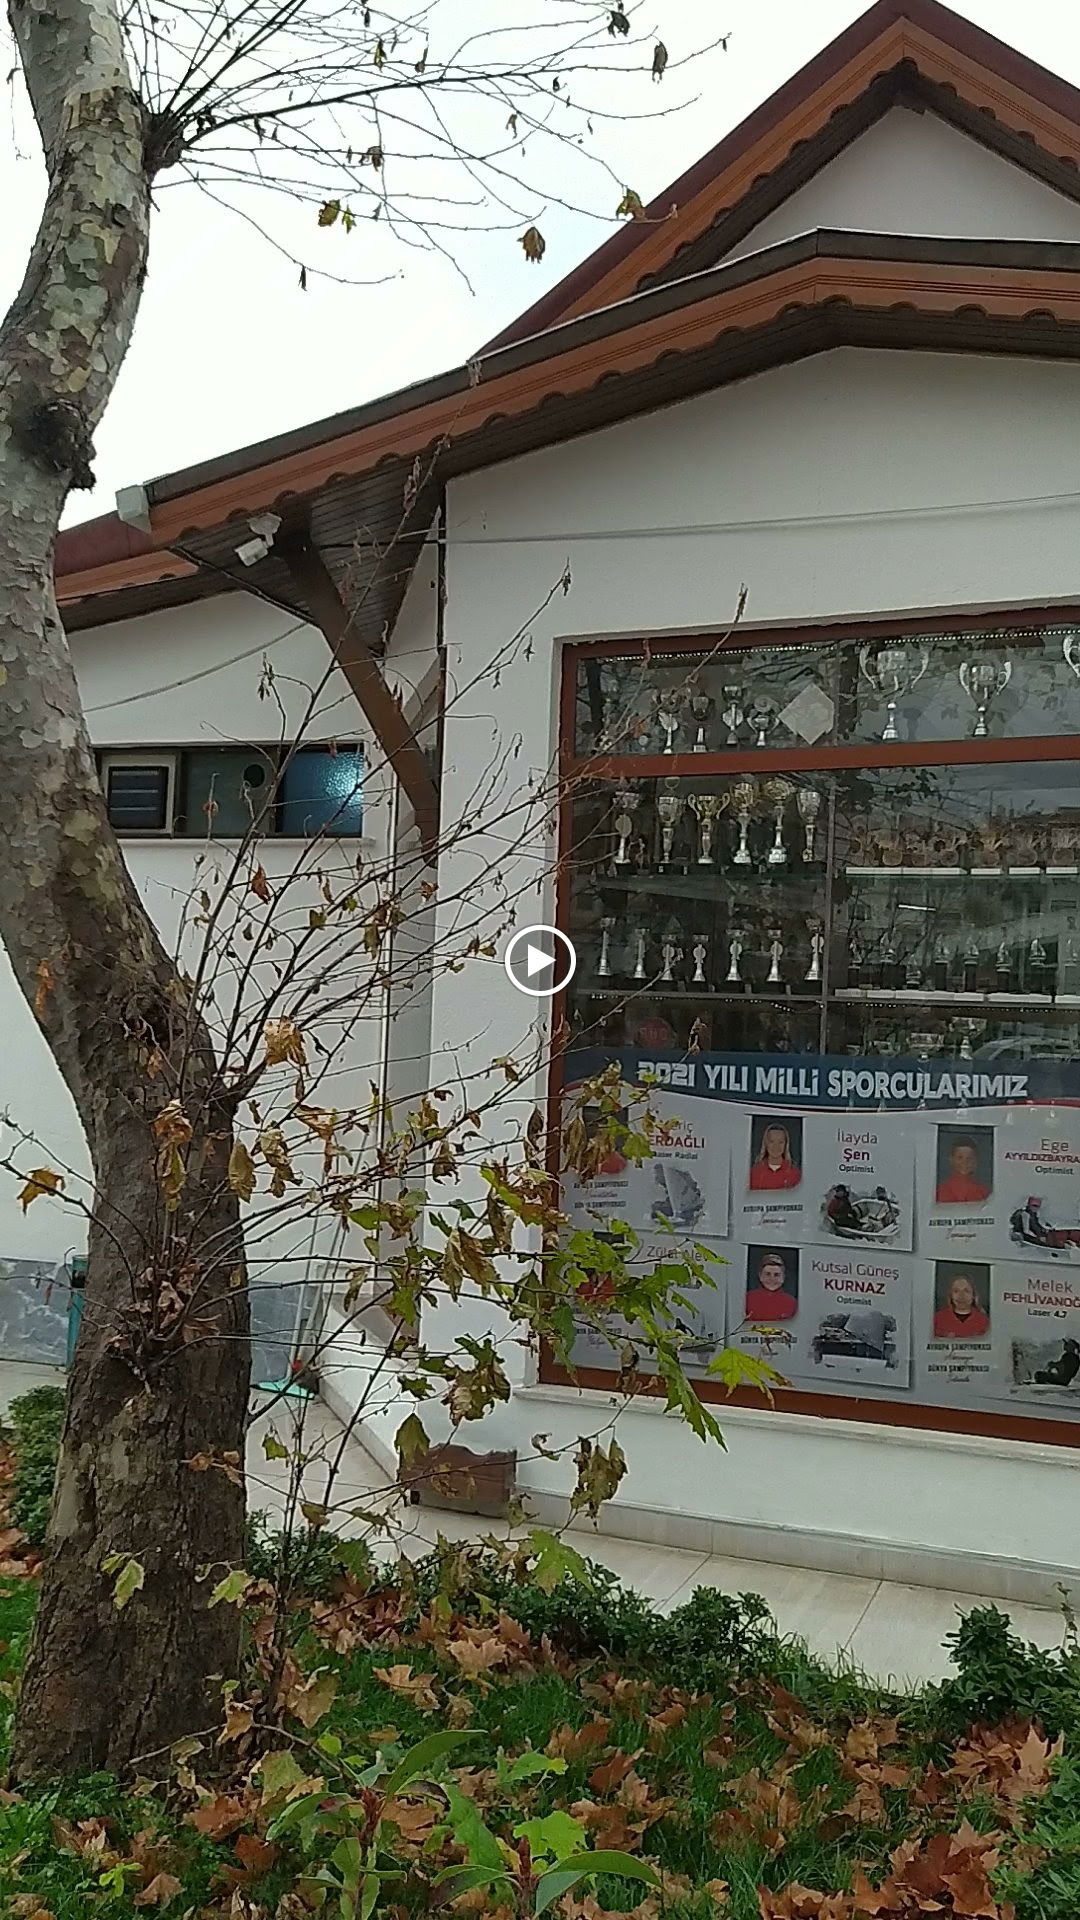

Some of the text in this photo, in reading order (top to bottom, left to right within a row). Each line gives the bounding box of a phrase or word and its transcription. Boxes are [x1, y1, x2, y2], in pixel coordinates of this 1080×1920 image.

[637, 1061, 696, 1087] 2021
[703, 1064, 748, 1093] YILI
[827, 1068, 1029, 1100] SPORCULARIMIZ
[649, 1134, 705, 1149] ERDAĞLI
[1041, 1138, 1069, 1154] Ege
[843, 1148, 870, 1162] Şen
[838, 1163, 875, 1174] Optimist
[1034, 1165, 1074, 1175] Optimist
[811, 1260, 900, 1281] Kutsal Güneş
[824, 1278, 886, 1295] KURNAZ
[1028, 1278, 1073, 1293] Melek
[836, 1295, 872, 1306] Optimist
[1028, 1309, 1051, 1317] Laser
